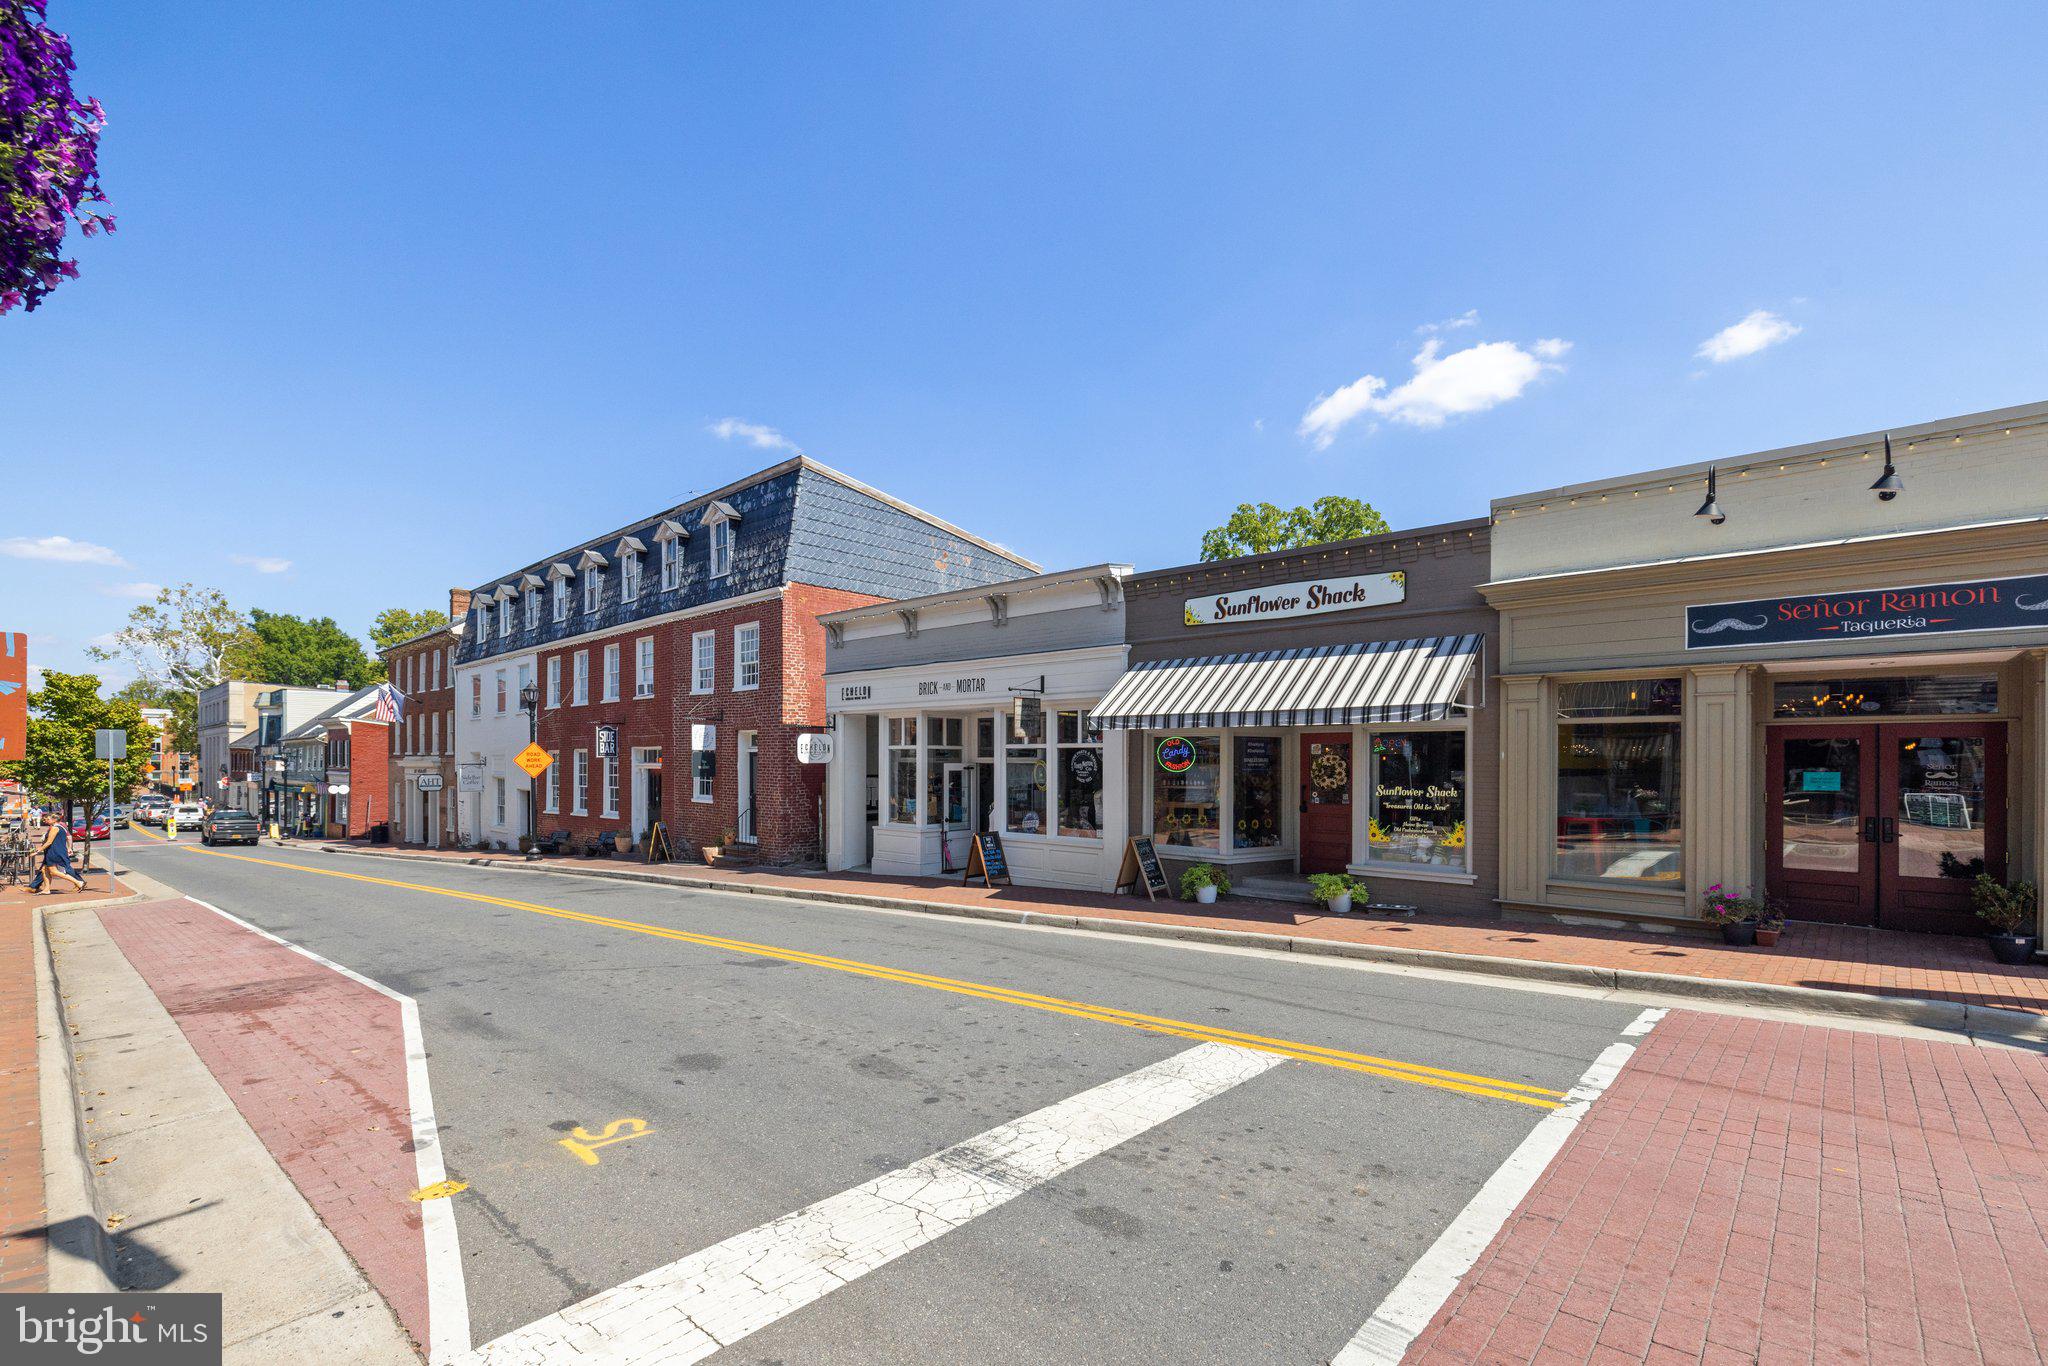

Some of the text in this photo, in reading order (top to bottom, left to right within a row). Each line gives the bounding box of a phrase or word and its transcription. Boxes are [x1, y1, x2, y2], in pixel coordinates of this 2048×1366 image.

[1214, 582, 1366, 620] Sunflower Shack
[1778, 586, 2000, 621] Señor Ramon
[1841, 615, 1926, 633] Taqueria
[841, 686, 871, 700] ECHELON
[918, 681, 939, 695] BRICK
[956, 677, 986, 693] MORTAR
[599, 731, 615, 742] SIDE
[1167, 738, 1180, 747] OLD
[599, 742, 615, 753] BAR
[800, 743, 830, 754] ECHELON
[1162, 744, 1190, 759] Candy
[1165, 759, 1190, 770] FASHION
[1924, 779, 1958, 787] Ramon
[1375, 784, 1458, 798] Sunflower Shack
